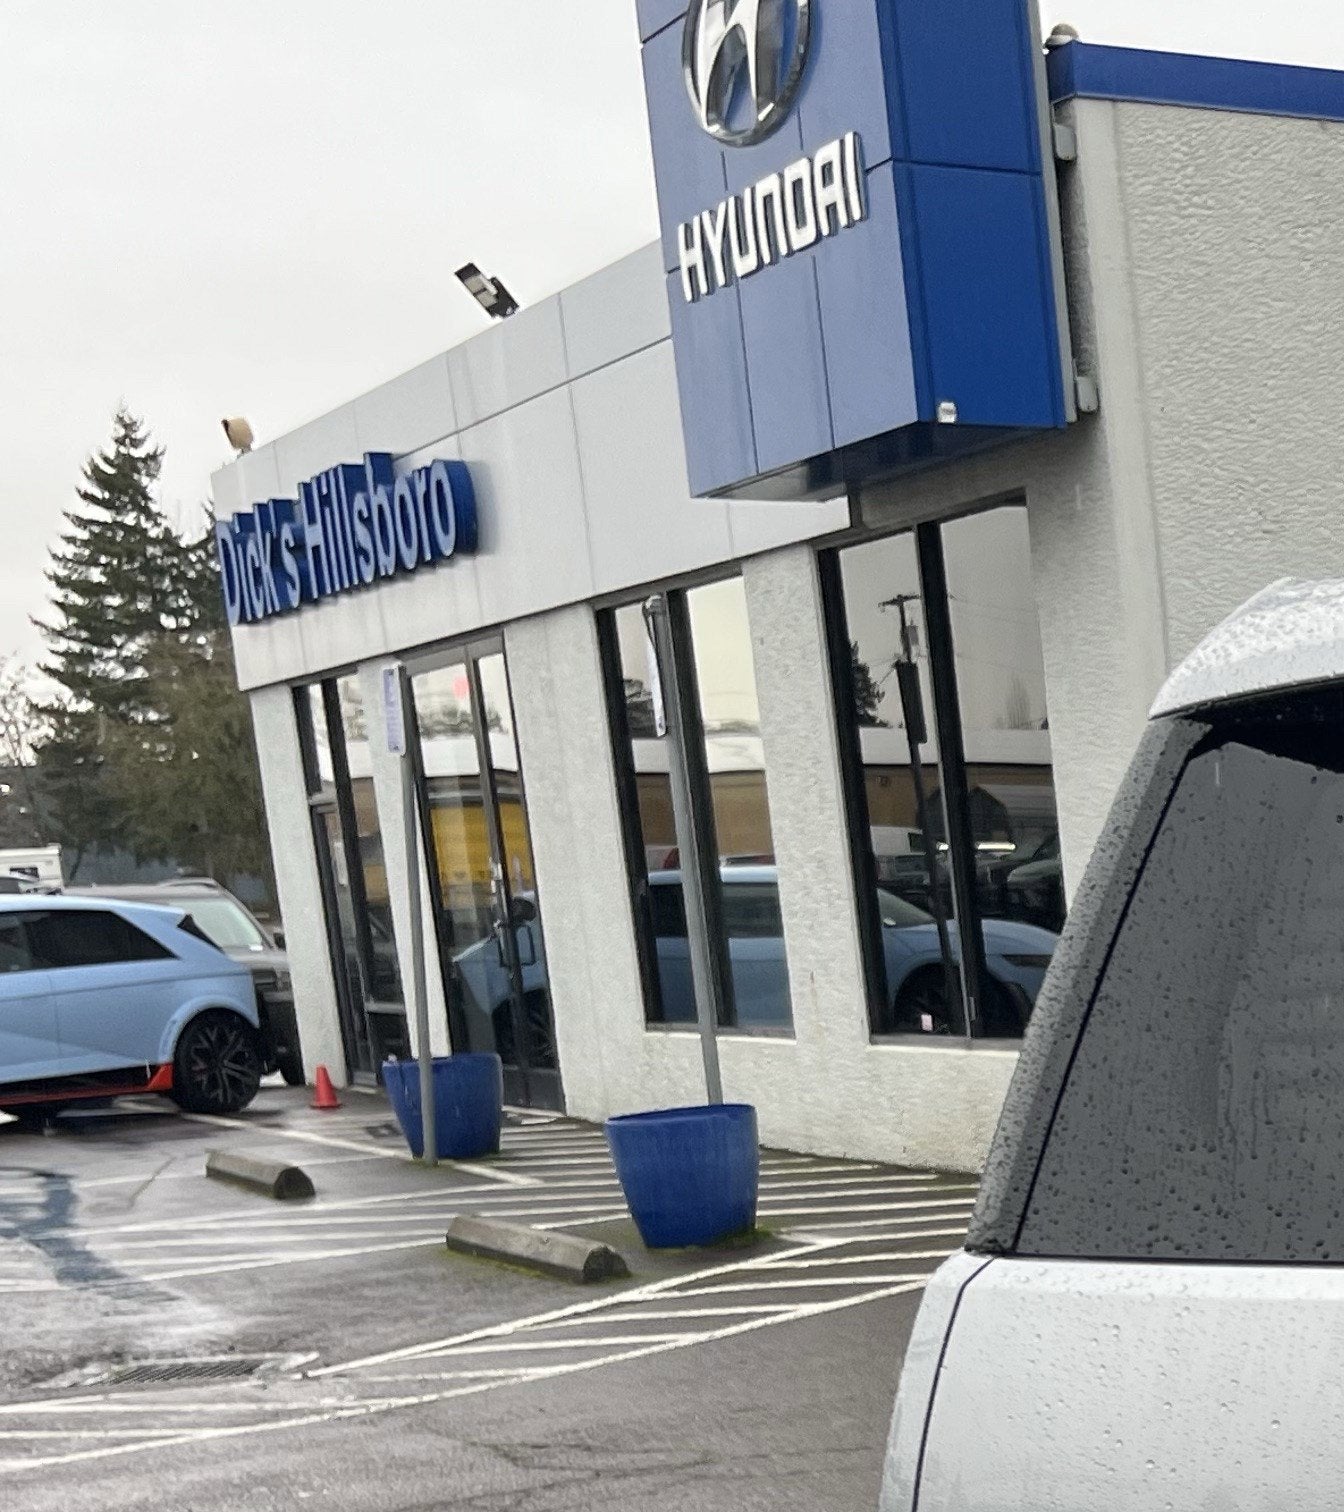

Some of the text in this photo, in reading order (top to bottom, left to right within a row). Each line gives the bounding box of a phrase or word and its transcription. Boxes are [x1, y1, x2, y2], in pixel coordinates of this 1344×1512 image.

[678, 131, 866, 302] HYUNDAI
[215, 453, 460, 626] Dick's Hillsboro
